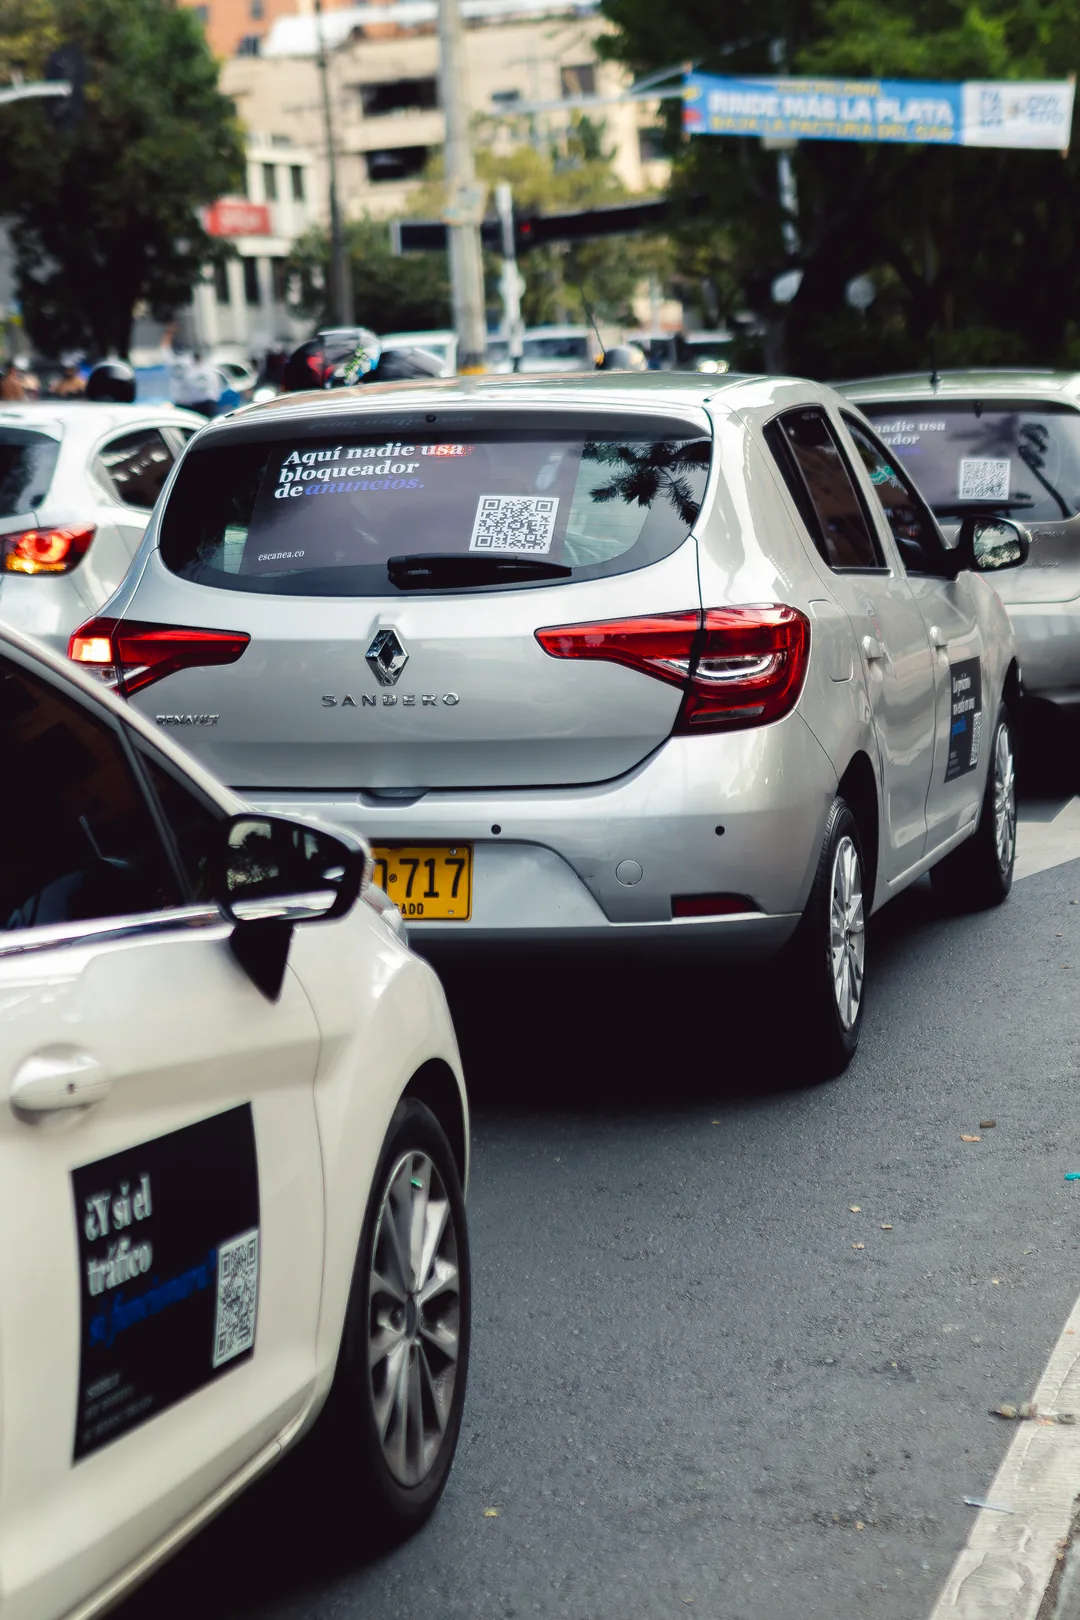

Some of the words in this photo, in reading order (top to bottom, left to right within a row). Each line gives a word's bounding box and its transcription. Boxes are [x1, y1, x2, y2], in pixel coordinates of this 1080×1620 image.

[708, 90, 779, 116] RINDE
[784, 92, 837, 120] MÁS
[840, 95, 873, 122] LA
[877, 97, 954, 126] PLATA
[764, 118, 787, 133] LA
[789, 119, 873, 137] FACTURA
[918, 421, 946, 432] usa
[282, 446, 343, 467] Aquí
[346, 443, 416, 461] nadie
[420, 443, 464, 457] usa
[279, 460, 421, 484] bloqueador
[274, 483, 304, 499] de
[304, 475, 425, 496] anuncios.
[257, 549, 306, 562] escanea.co
[321, 692, 461, 708] SANDERO
[155, 713, 221, 727] RENAULT
[84, 1192, 112, 1242] ¿Y
[112, 1181, 133, 1231] si
[133, 1173, 153, 1222] el
[87, 1237, 153, 1297] tráfico
